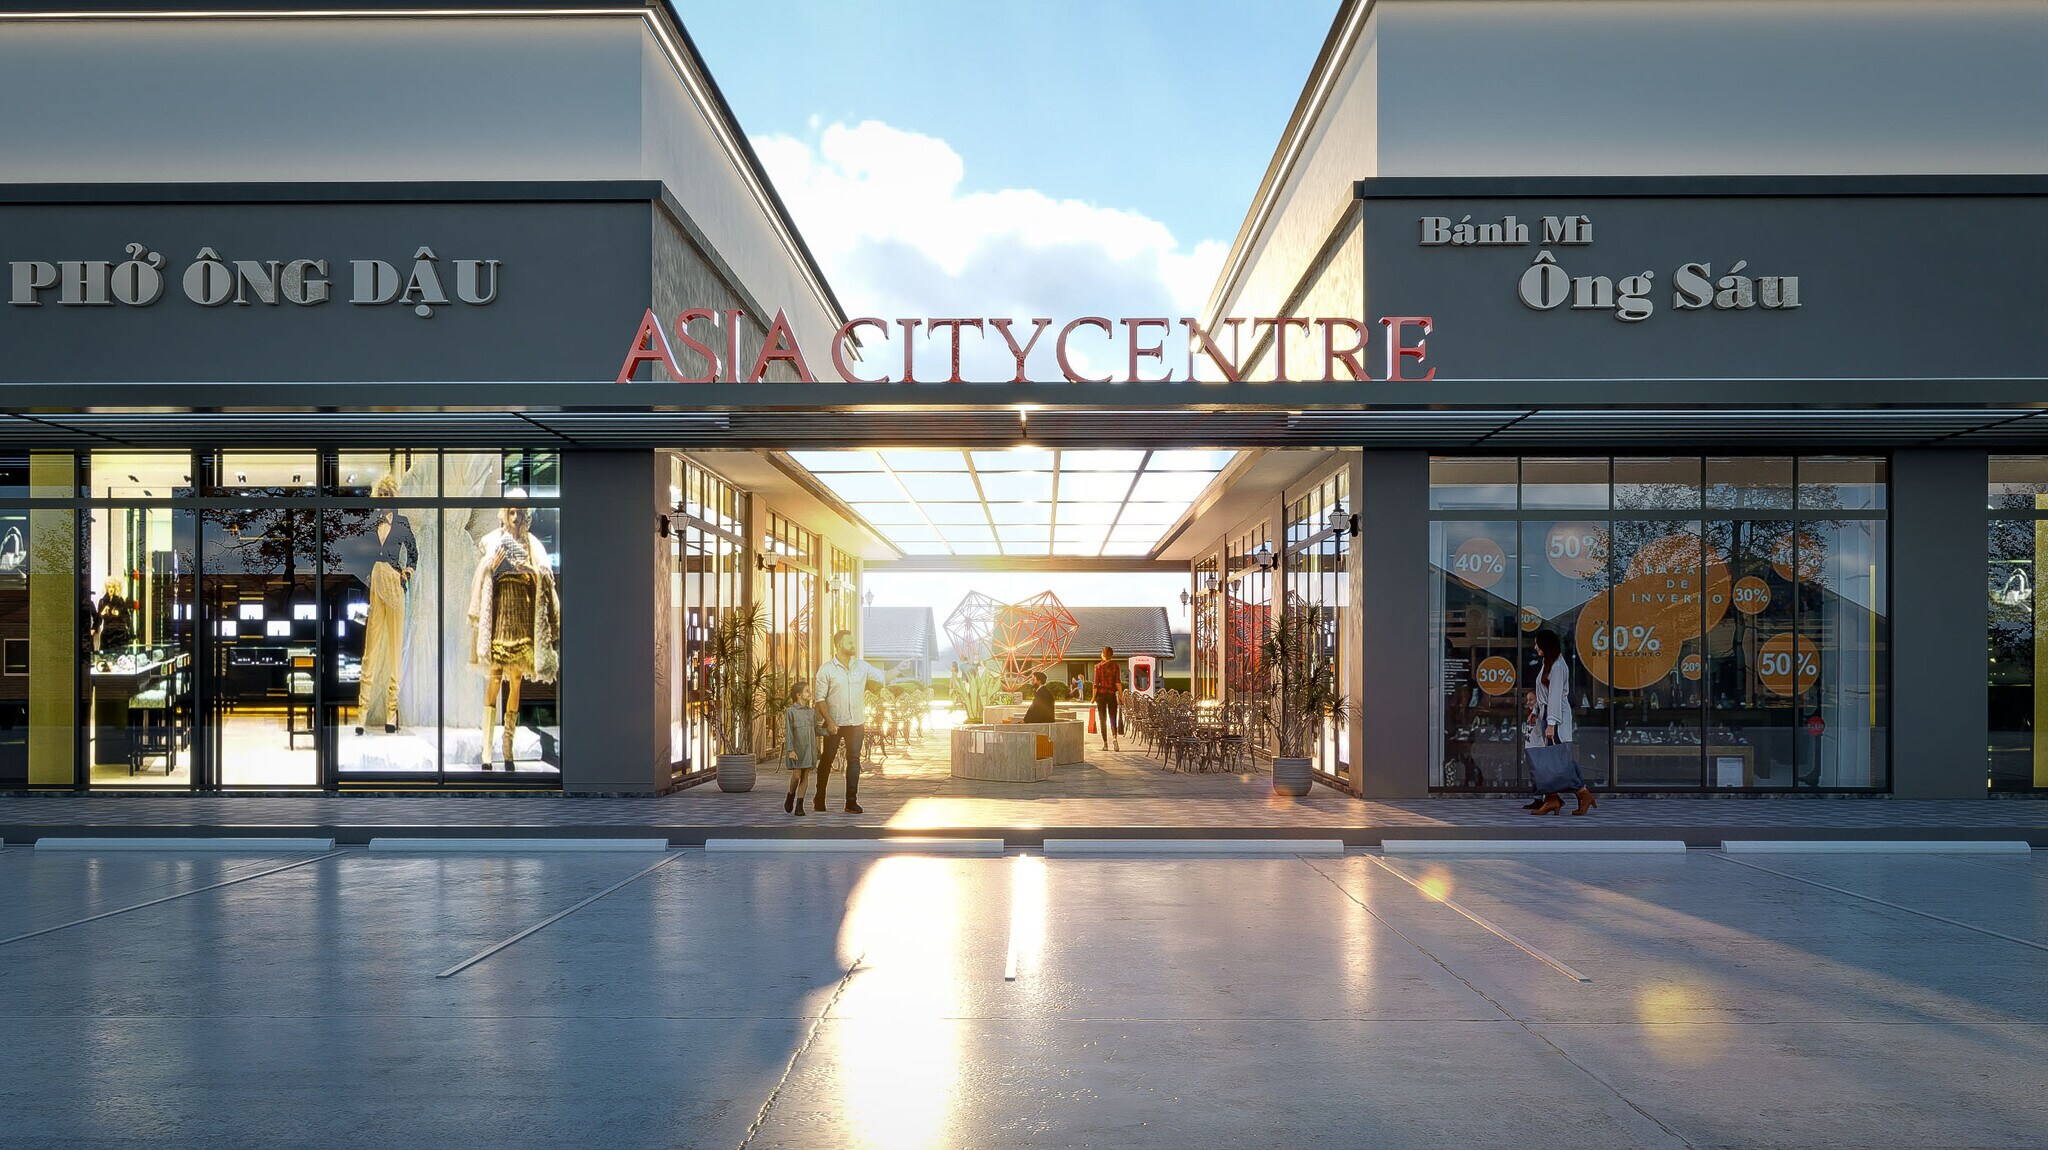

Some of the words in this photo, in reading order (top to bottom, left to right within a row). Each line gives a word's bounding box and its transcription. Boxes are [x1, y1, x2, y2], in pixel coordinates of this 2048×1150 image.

[1419, 214, 1531, 246] Bánh
[1540, 214, 1594, 246] Mì
[8, 242, 167, 307] PHỞ
[182, 246, 332, 306] ÔNG
[349, 246, 501, 319] DẬU
[1517, 250, 1655, 322] Ông
[1672, 259, 1802, 310] Sáu
[615, 306, 819, 384] ASIA
[1550, 533, 1609, 560] 50%
[1455, 553, 1504, 574] 40%
[1665, 579, 1689, 589] DE
[1735, 588, 1768, 603] 30%
[1631, 593, 1723, 604] INVERO
[1591, 625, 1661, 652] 60%
[1479, 668, 1514, 683] 30%
[1761, 653, 1818, 676] 50%
